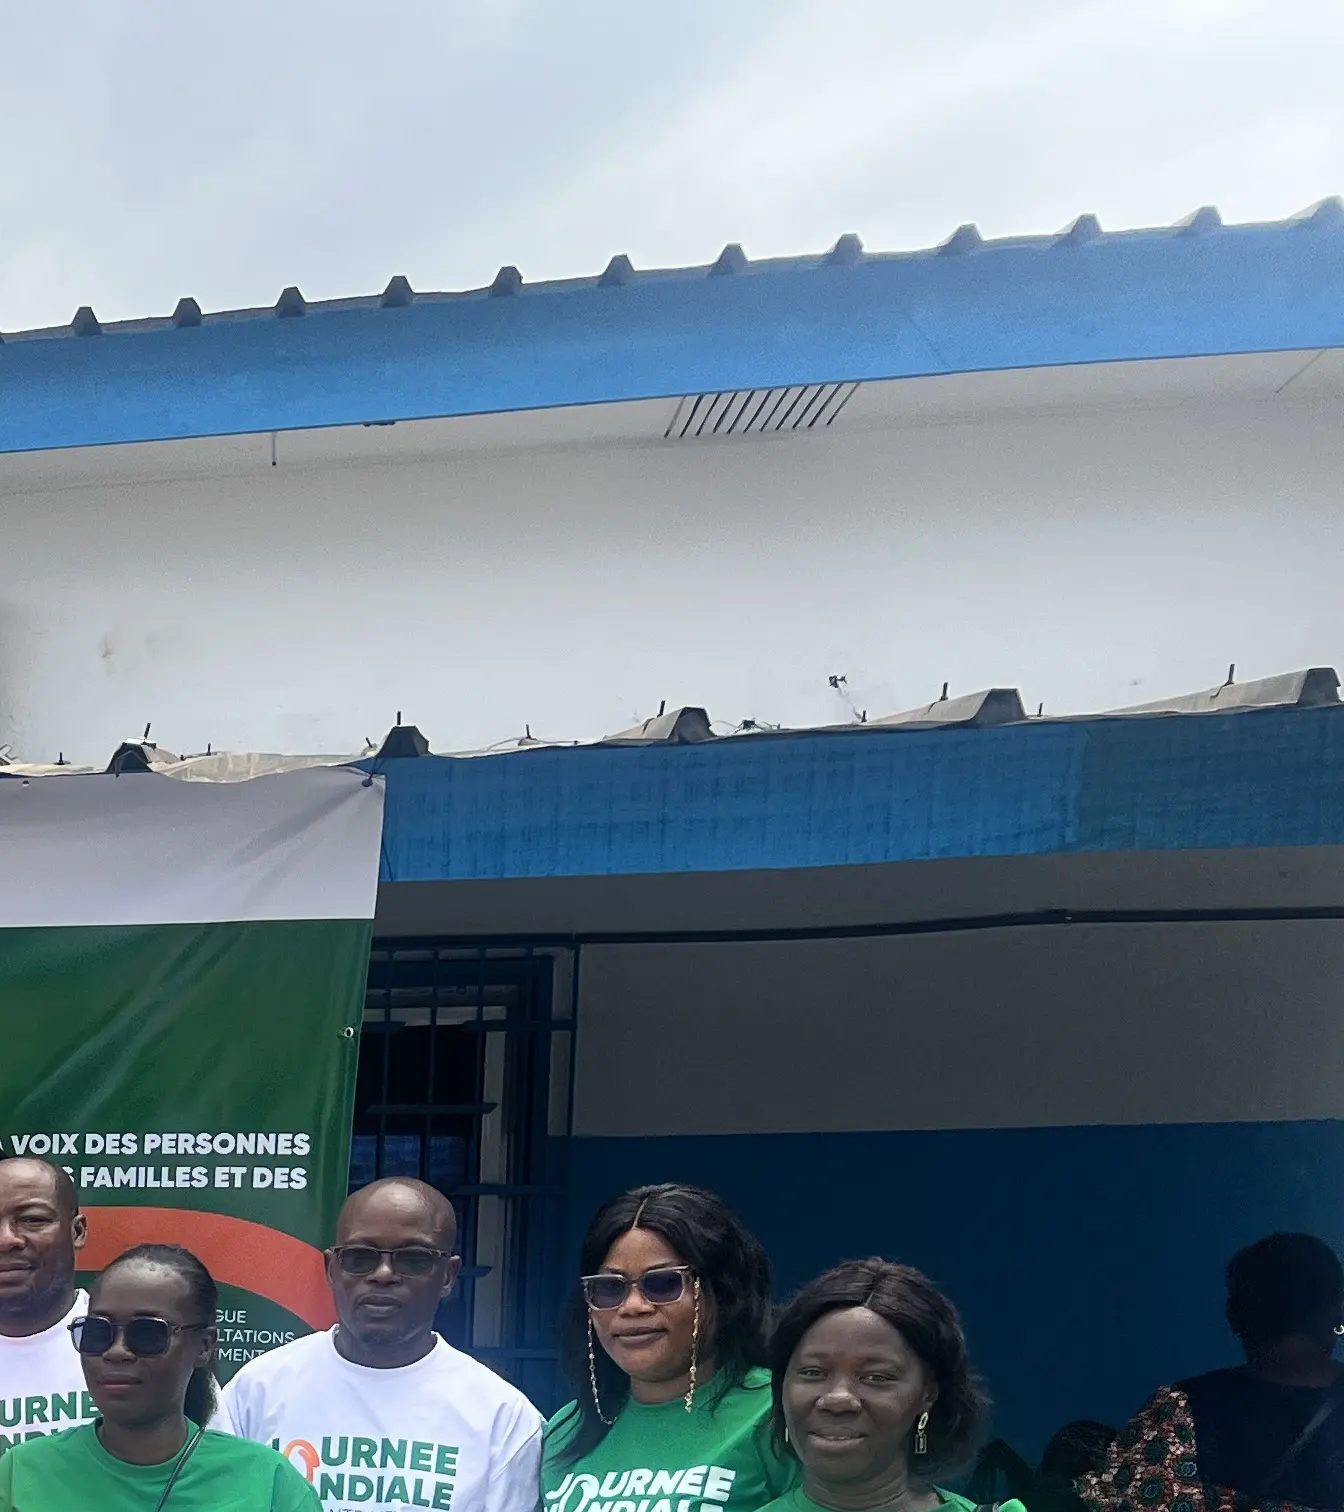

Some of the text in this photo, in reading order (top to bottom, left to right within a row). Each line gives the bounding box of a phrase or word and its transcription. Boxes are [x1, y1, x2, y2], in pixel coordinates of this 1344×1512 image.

[11, 1133, 79, 1155] VOIX
[85, 1133, 138, 1155] DES
[144, 1132, 311, 1156] PERSONNES
[81, 1166, 209, 1189] FAMILLES
[214, 1166, 247, 1189] ET
[252, 1166, 309, 1190] DES
[216, 1328, 295, 1344] LTATIONS
[319, 1472, 454, 1511] NDIALE
[545, 1465, 736, 1502] JOURNEE
